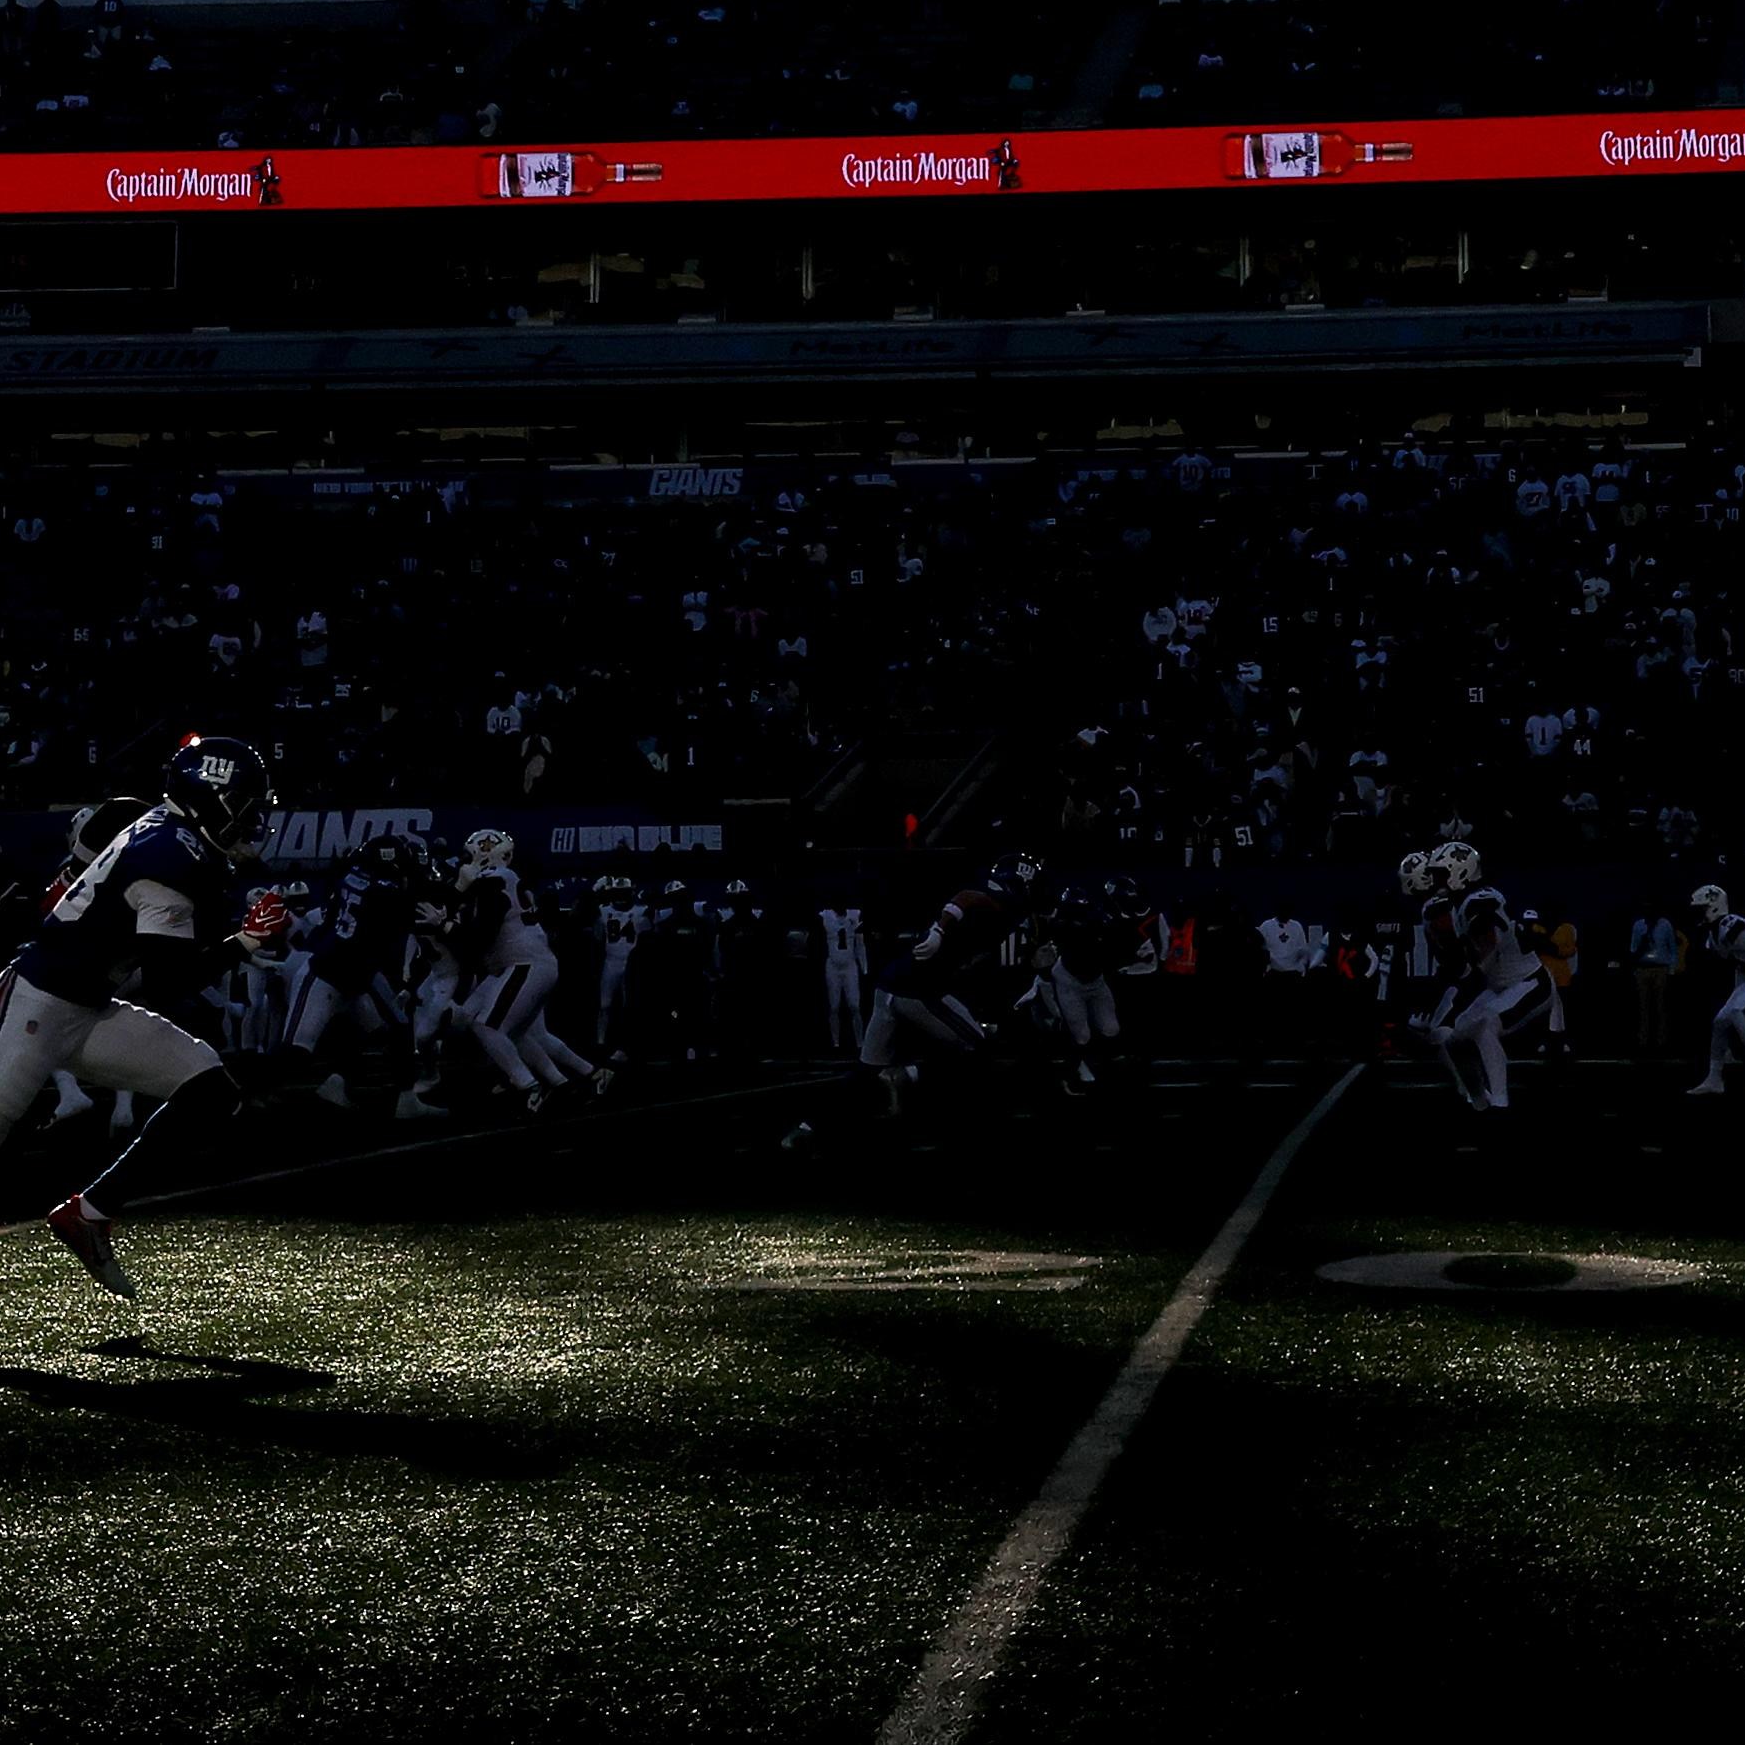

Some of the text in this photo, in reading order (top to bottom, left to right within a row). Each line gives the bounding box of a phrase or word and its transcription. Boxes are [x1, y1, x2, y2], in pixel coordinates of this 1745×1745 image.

[1600, 130, 1674, 165] Captain
[107, 168, 251, 202] Captain Morgan
[842, 152, 989, 188] Captain Morgan
[5, 348, 221, 372] STADIUM
[649, 467, 744, 496] GIANTS
[1234, 827, 1253, 846] 51
